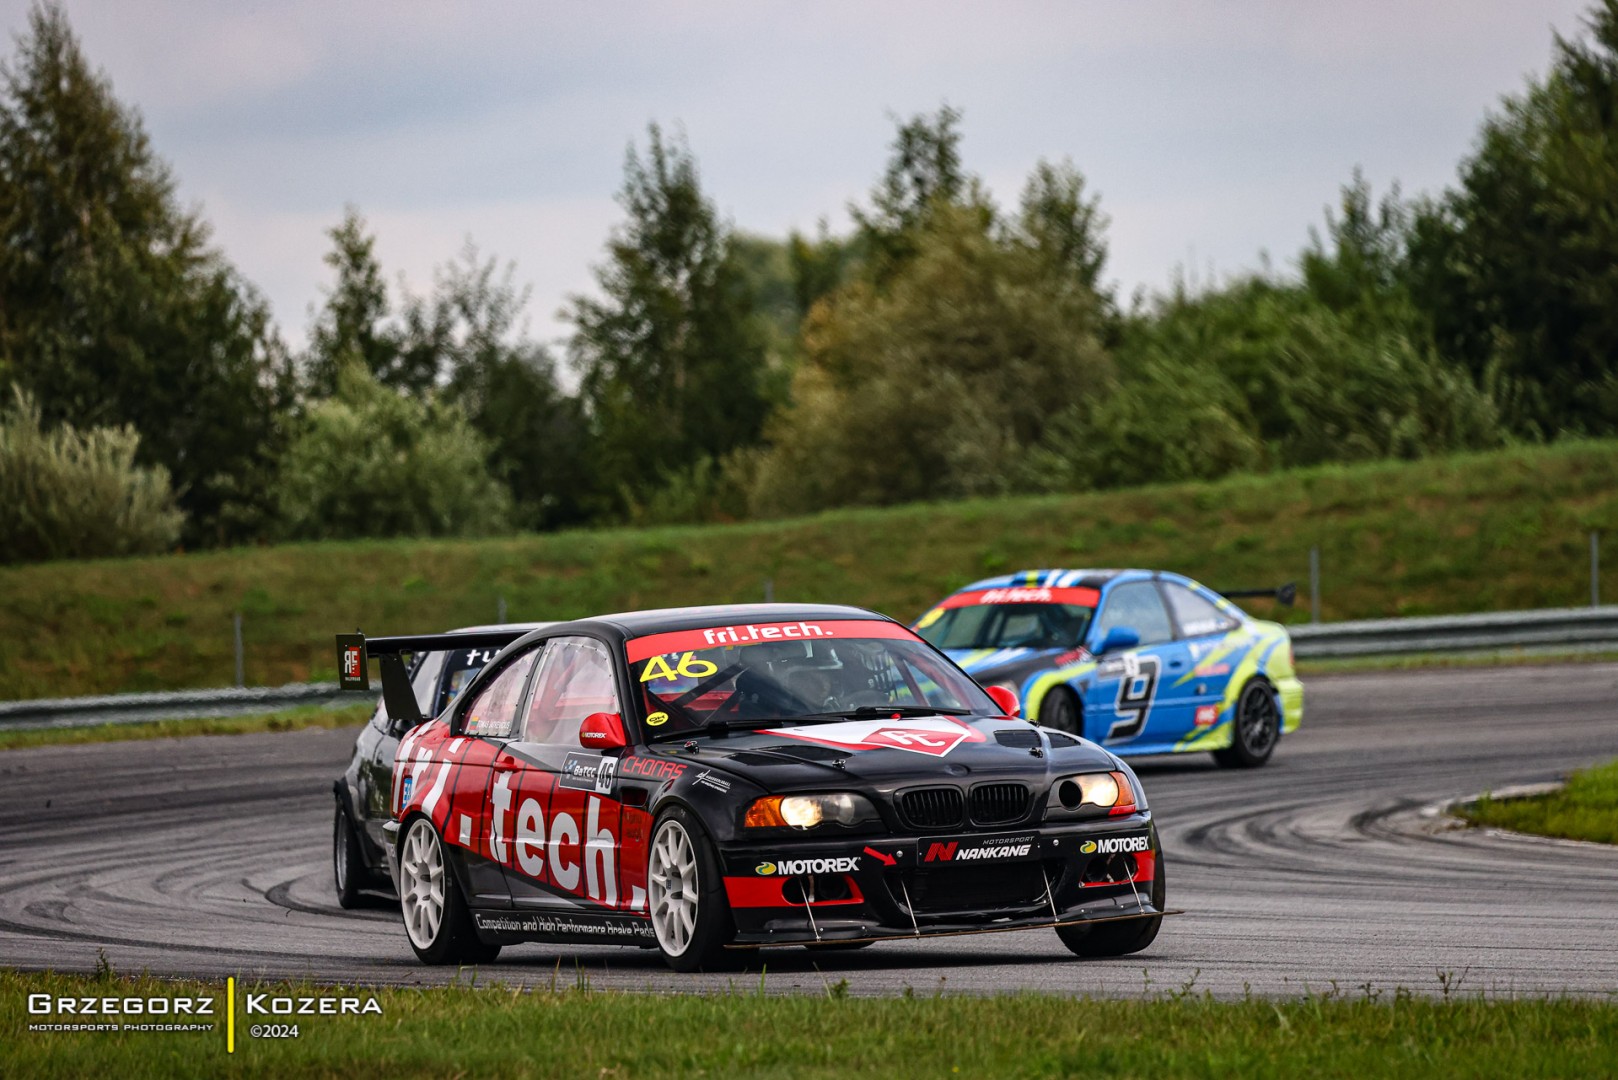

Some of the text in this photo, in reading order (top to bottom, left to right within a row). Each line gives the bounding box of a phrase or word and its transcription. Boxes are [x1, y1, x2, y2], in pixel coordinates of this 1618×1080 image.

[703, 622, 834, 644] fri.tech.
[640, 651, 719, 683] 46
[1105, 656, 1158, 744] 9
[573, 765, 597, 778] BaTCC
[598, 762, 614, 789] 46
[982, 836, 1035, 845] MOTORSPORT
[1097, 836, 1149, 853] MOTOREX
[956, 844, 1031, 861] NANKANG
[777, 857, 860, 875] MOTOREX
[475, 913, 520, 934] Competition
[522, 915, 537, 931] and
[539, 915, 556, 935] High
[557, 917, 606, 934] Performance
[606, 921, 632, 936] Brake
